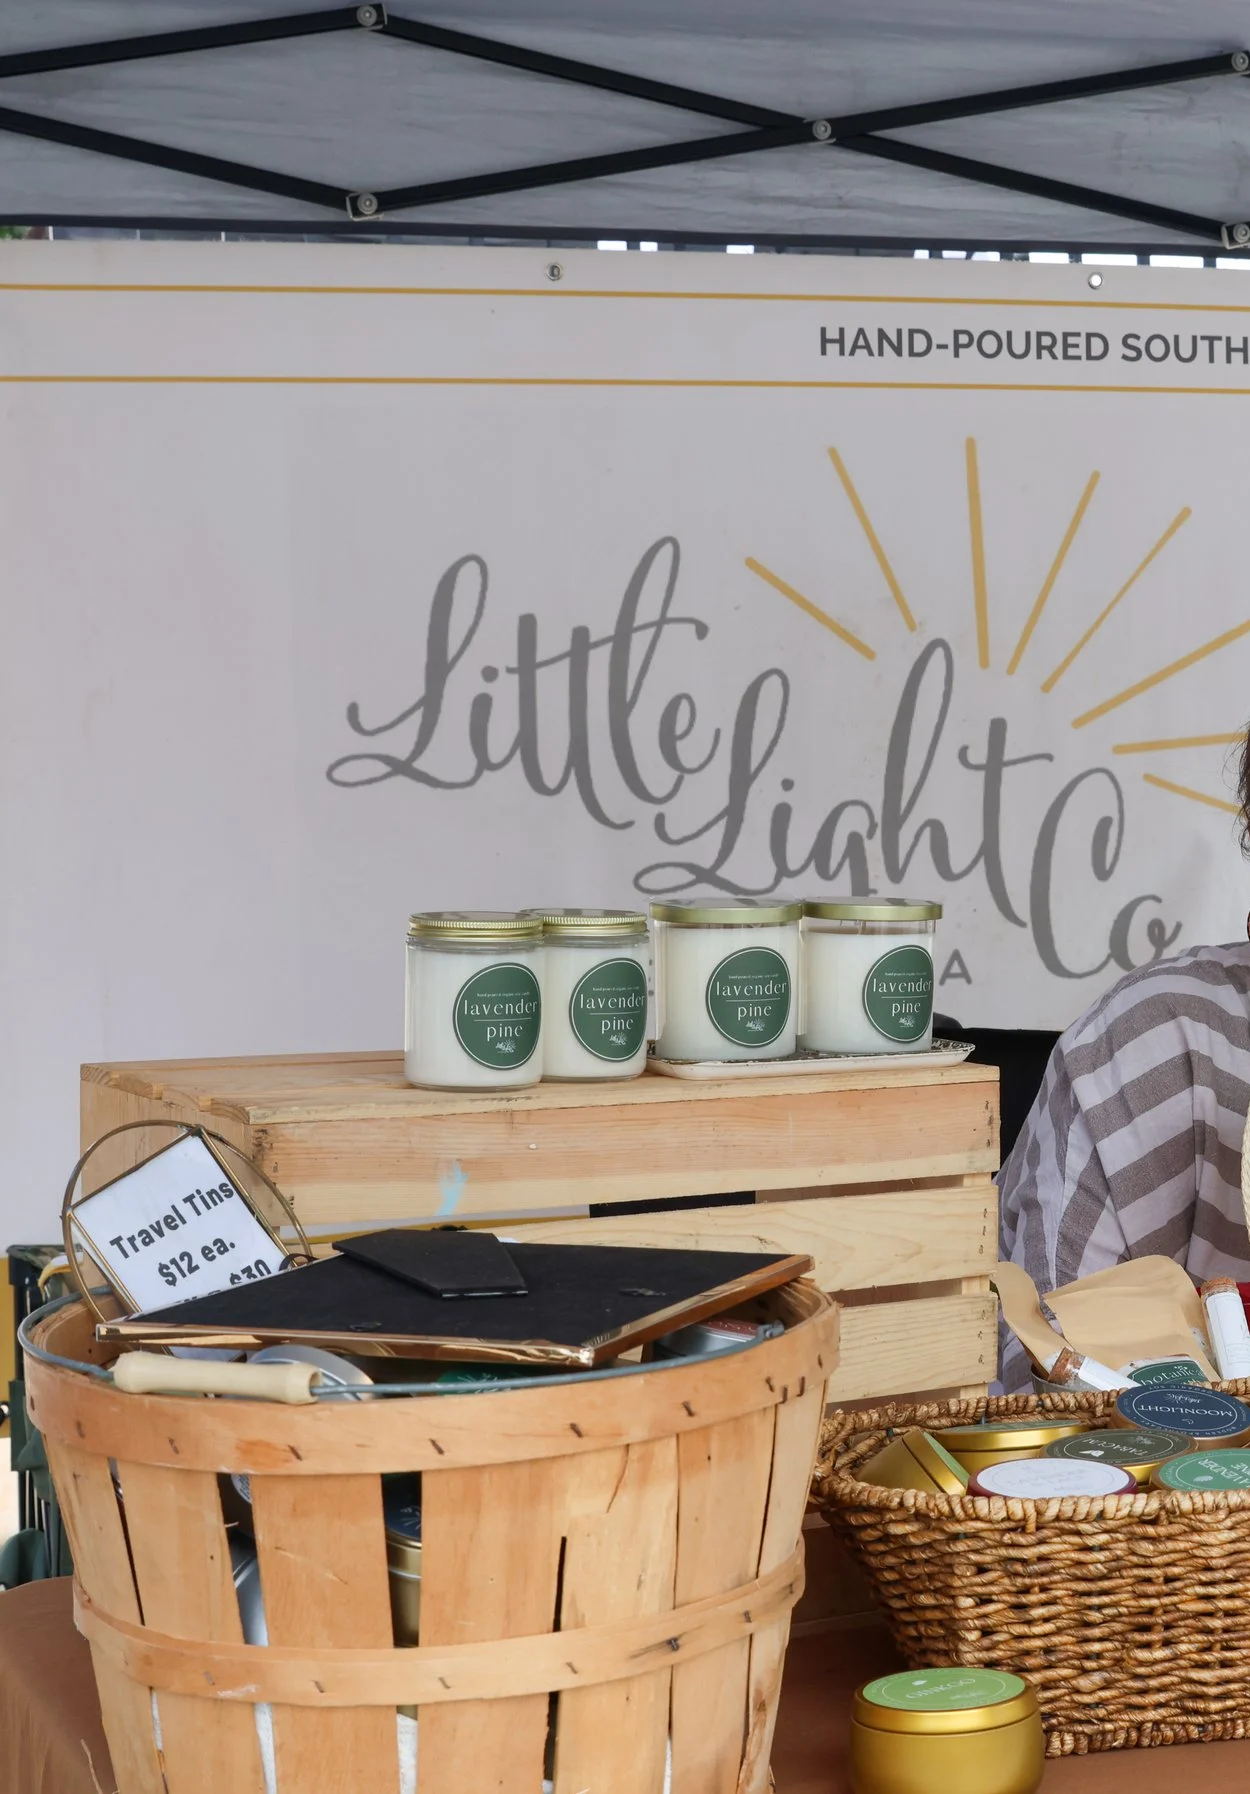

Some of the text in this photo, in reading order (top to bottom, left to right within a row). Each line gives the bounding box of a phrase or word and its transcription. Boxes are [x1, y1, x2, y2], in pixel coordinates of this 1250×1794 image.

[820, 325, 1111, 362] HAND-POURED
[325, 535, 722, 831] Little
[633, 637, 1055, 929] Light
[715, 979, 788, 997] lavender
[873, 977, 933, 994] lavender
[463, 998, 539, 1016] lavender
[580, 992, 647, 1010] lavender
[891, 1000, 921, 1017] pine
[737, 1003, 773, 1022] pine
[486, 1023, 524, 1043] pine
[601, 1016, 635, 1035] pine
[109, 1181, 236, 1261] Travel Tins
[158, 1237, 236, 1287] $12 ea.
[1138, 1404, 1233, 1417] MOONLIGHT
